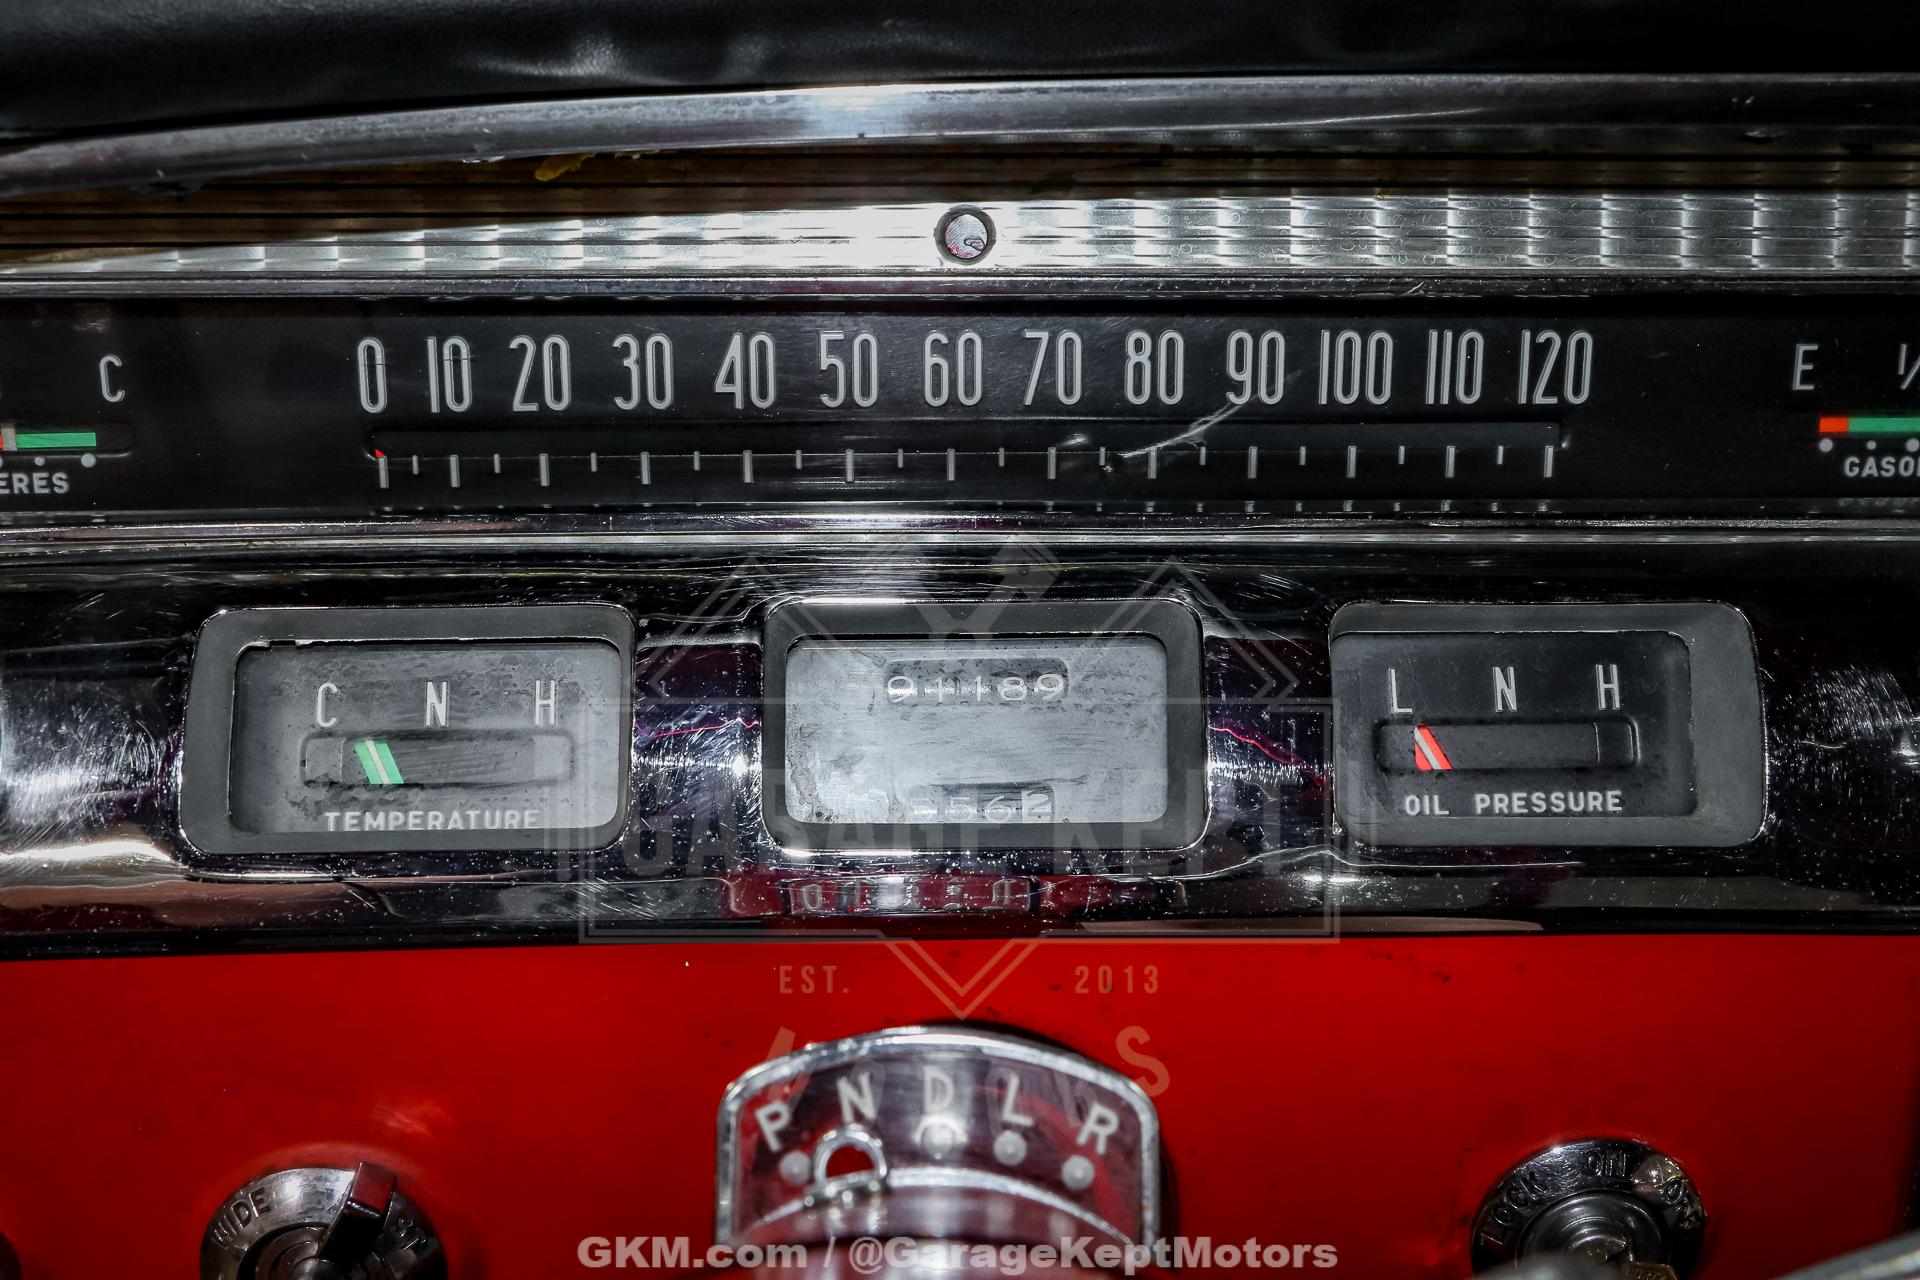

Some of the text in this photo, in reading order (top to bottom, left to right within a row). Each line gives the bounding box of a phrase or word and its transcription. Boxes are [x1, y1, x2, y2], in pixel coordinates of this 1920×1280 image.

[100, 354, 126, 402] C
[357, 329, 1593, 413] 0 10 20 30 40 50 60 70 80 90 100 110 120
[1793, 343, 1819, 390] E
[1843, 456, 1920, 477] GASO
[316, 680, 558, 728] C N H
[1388, 664, 1621, 714] L N H
[325, 809, 539, 831] TEMPERATURE
[1405, 790, 1623, 816] OIL PRESSURE
[755, 1067, 1120, 1155] P N D L R
